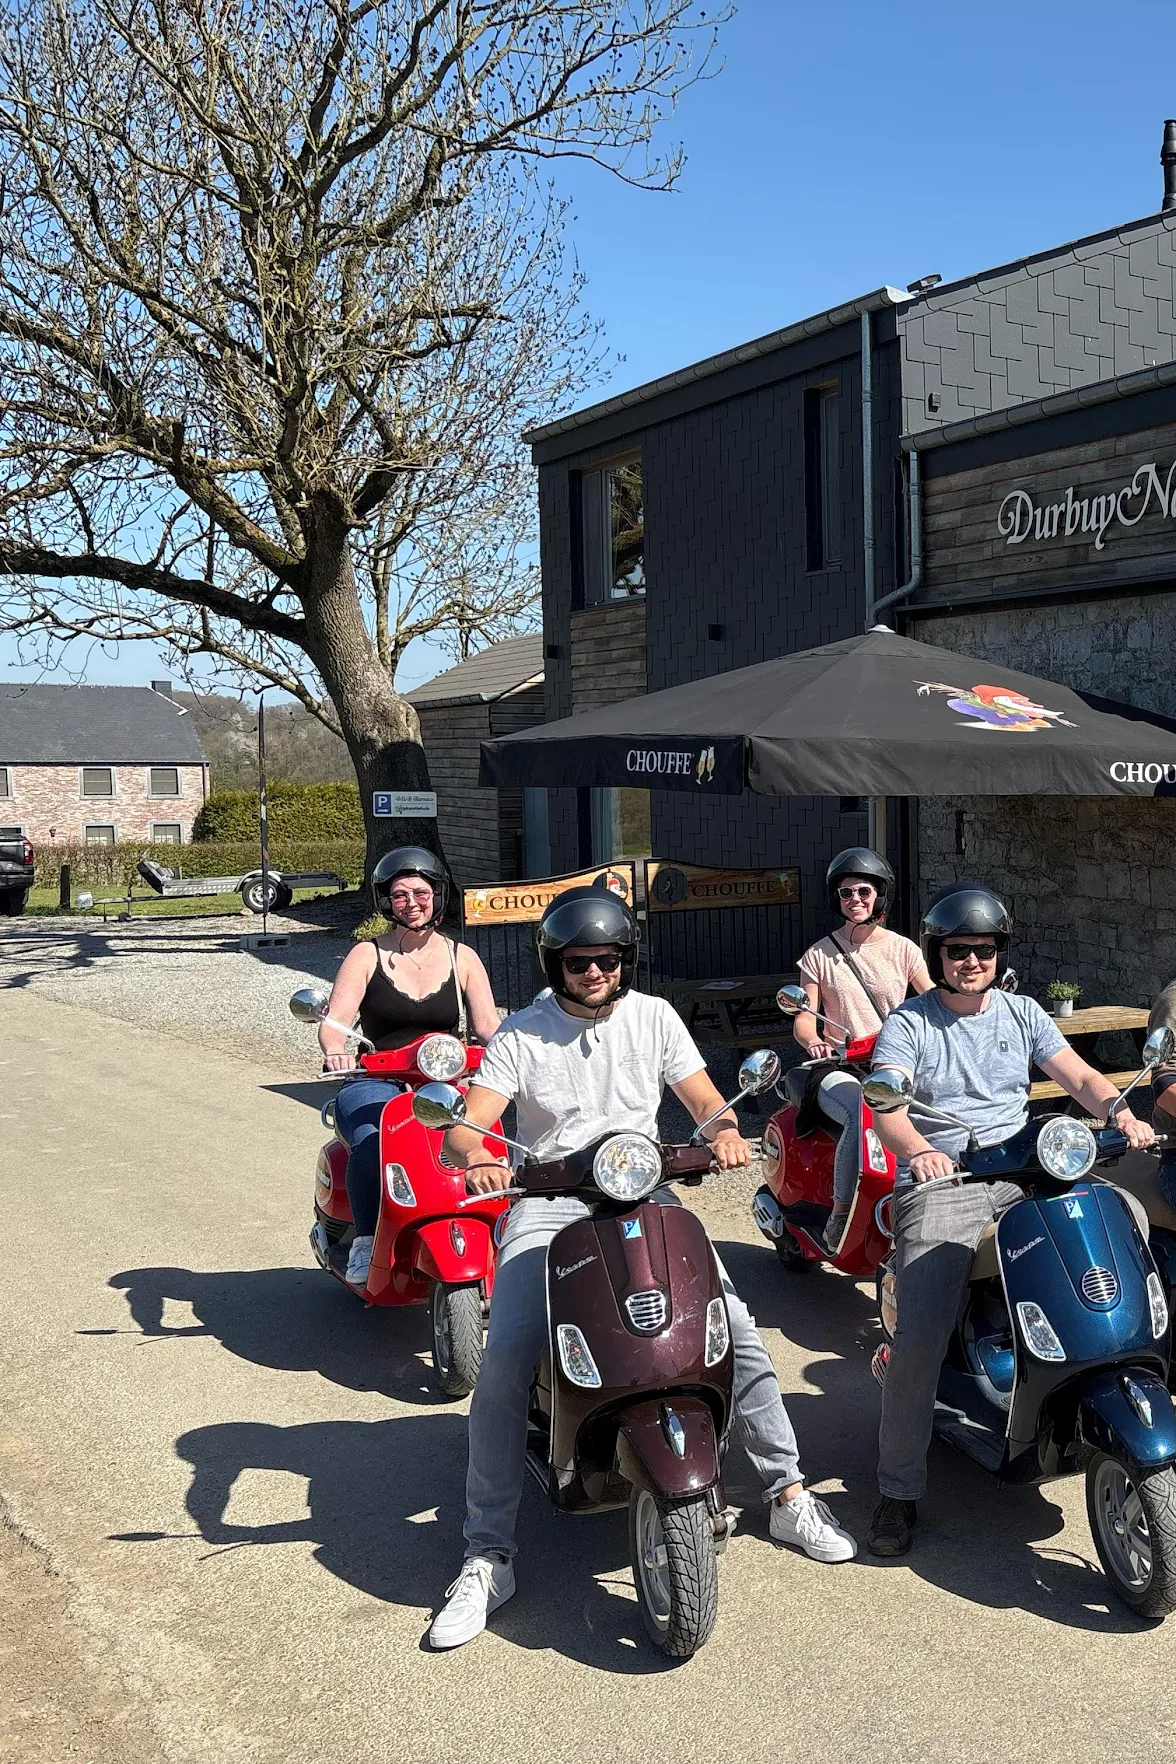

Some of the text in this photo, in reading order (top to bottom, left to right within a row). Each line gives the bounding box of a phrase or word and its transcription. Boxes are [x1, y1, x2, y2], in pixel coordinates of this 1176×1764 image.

[626, 749, 692, 775] CHOUFFE
[378, 795, 389, 808] P
[691, 880, 776, 898] CHOUFFE
[489, 892, 557, 911] CHOU
